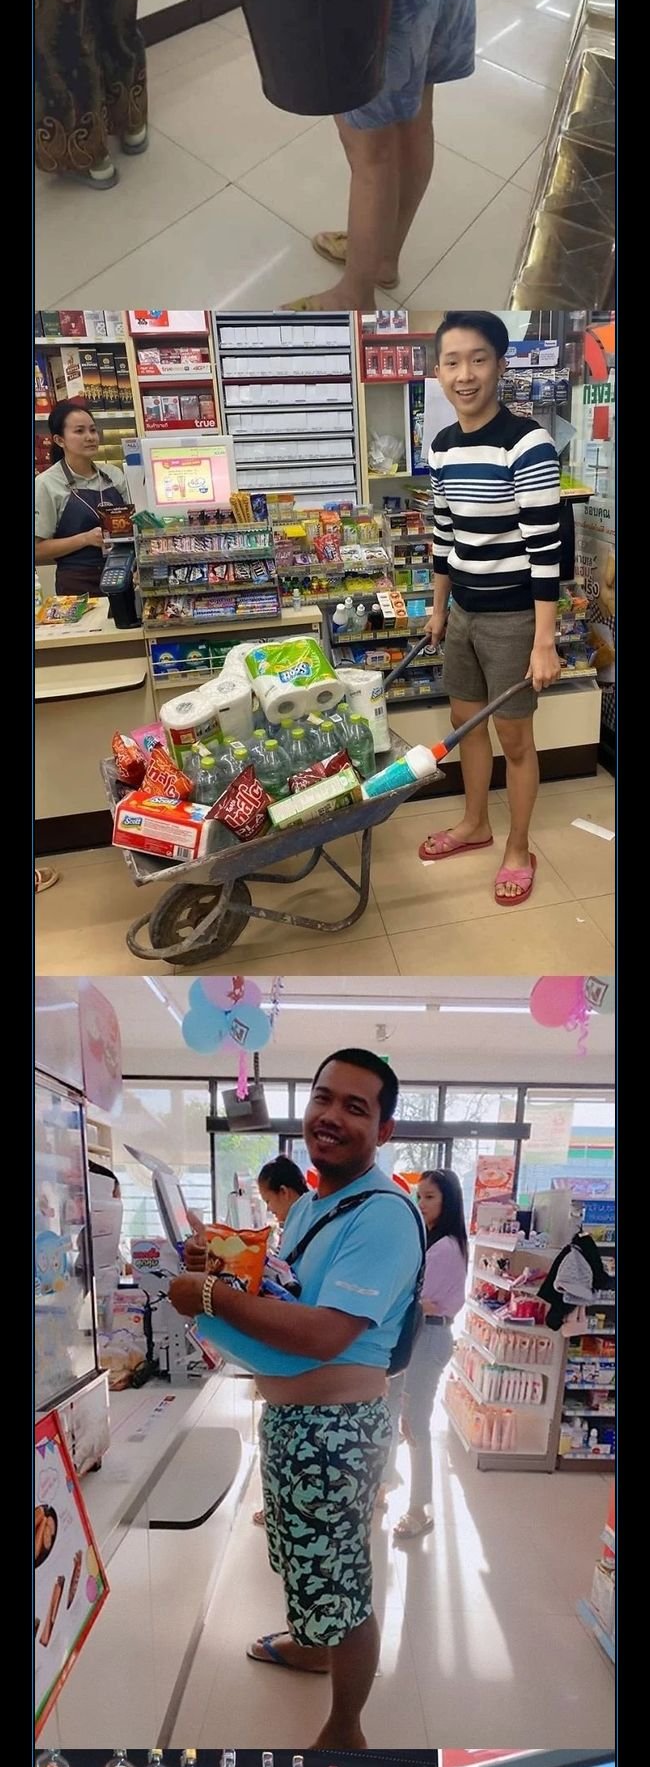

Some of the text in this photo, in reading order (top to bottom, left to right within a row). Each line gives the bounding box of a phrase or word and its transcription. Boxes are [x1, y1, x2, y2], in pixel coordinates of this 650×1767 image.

[194, 417, 215, 428] true
[584, 505, 611, 522] ขอบคุณ
[125, 816, 140, 826] Scott
